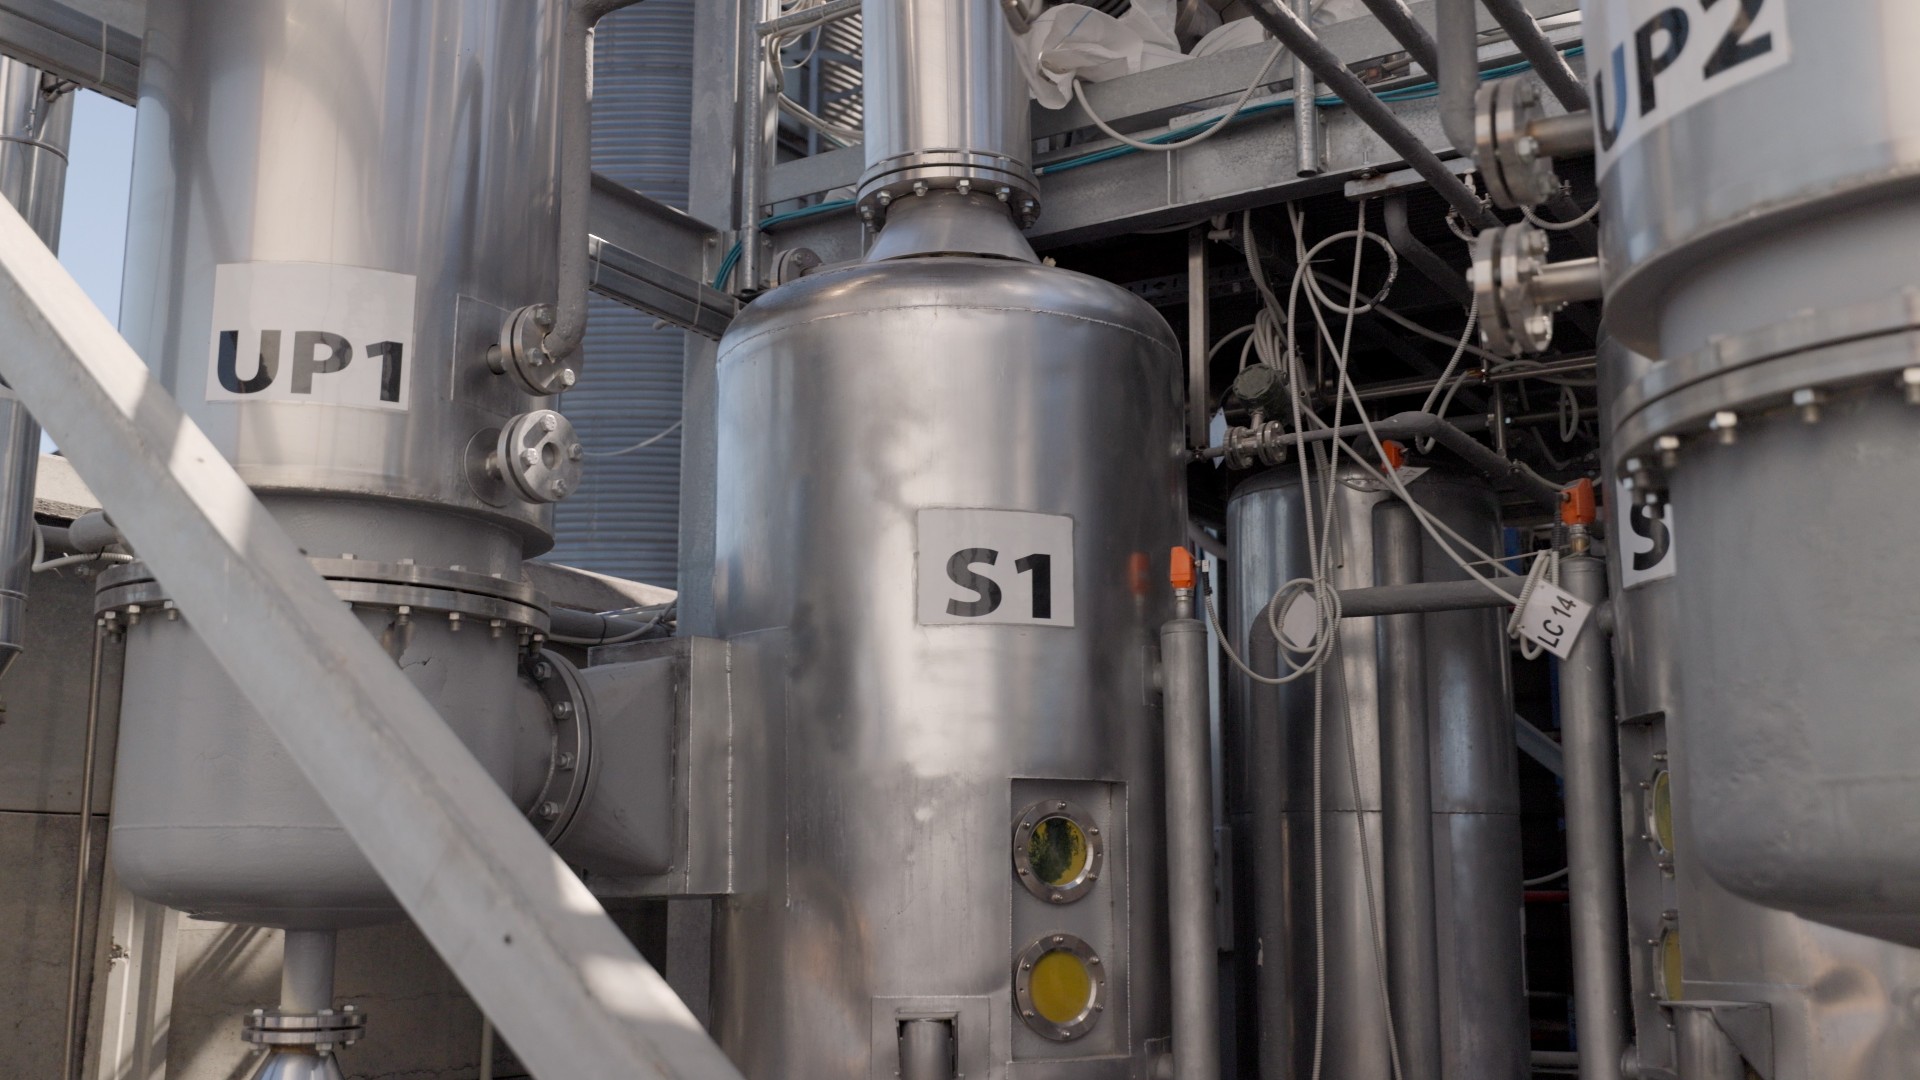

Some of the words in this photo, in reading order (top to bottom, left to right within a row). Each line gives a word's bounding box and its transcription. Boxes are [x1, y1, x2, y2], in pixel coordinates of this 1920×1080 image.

[1594, 0, 1772, 153] UP2
[217, 329, 403, 403] UP1
[945, 547, 1051, 619] S1
[1537, 619, 1564, 648] LC
[1551, 595, 1577, 618] 14
